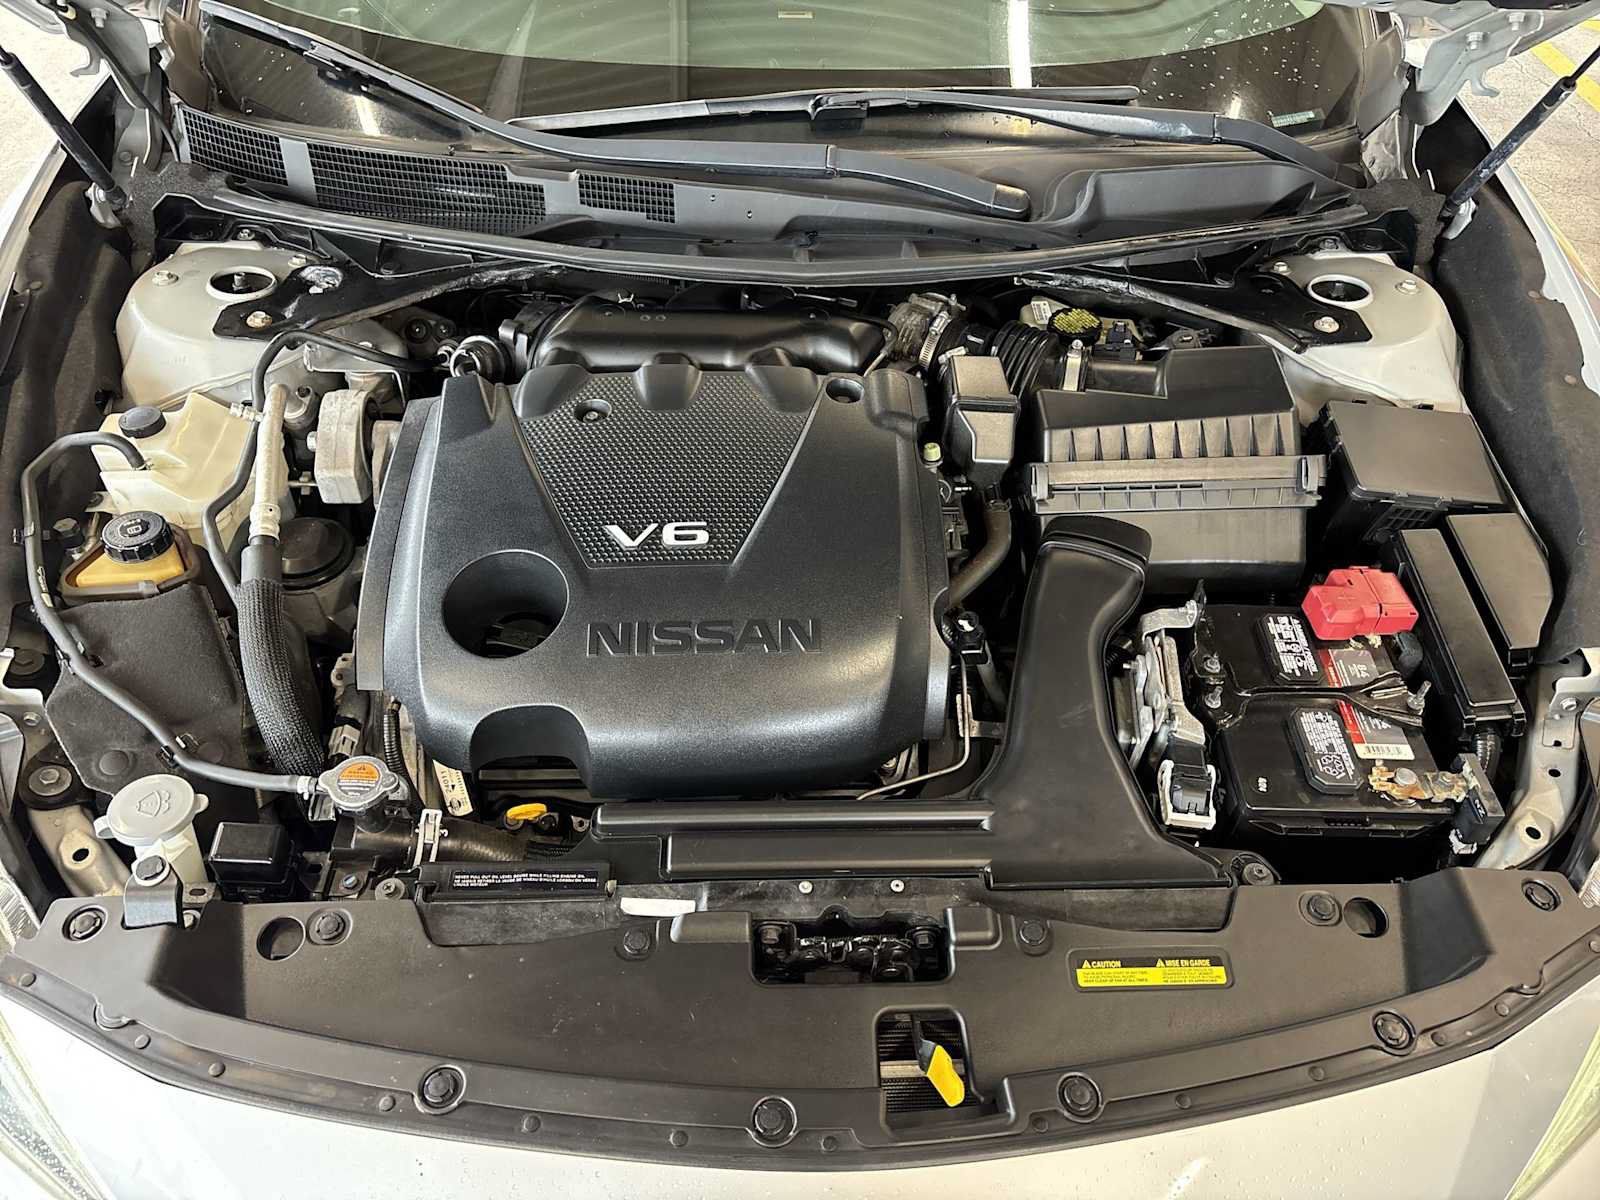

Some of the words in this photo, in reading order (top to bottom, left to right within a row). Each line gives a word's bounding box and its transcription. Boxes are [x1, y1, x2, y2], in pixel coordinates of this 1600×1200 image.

[602, 521, 710, 549] V6
[587, 619, 822, 657] NISSAN
[1091, 960, 1121, 969] CAUTION
[1190, 959, 1211, 968] GARDE
